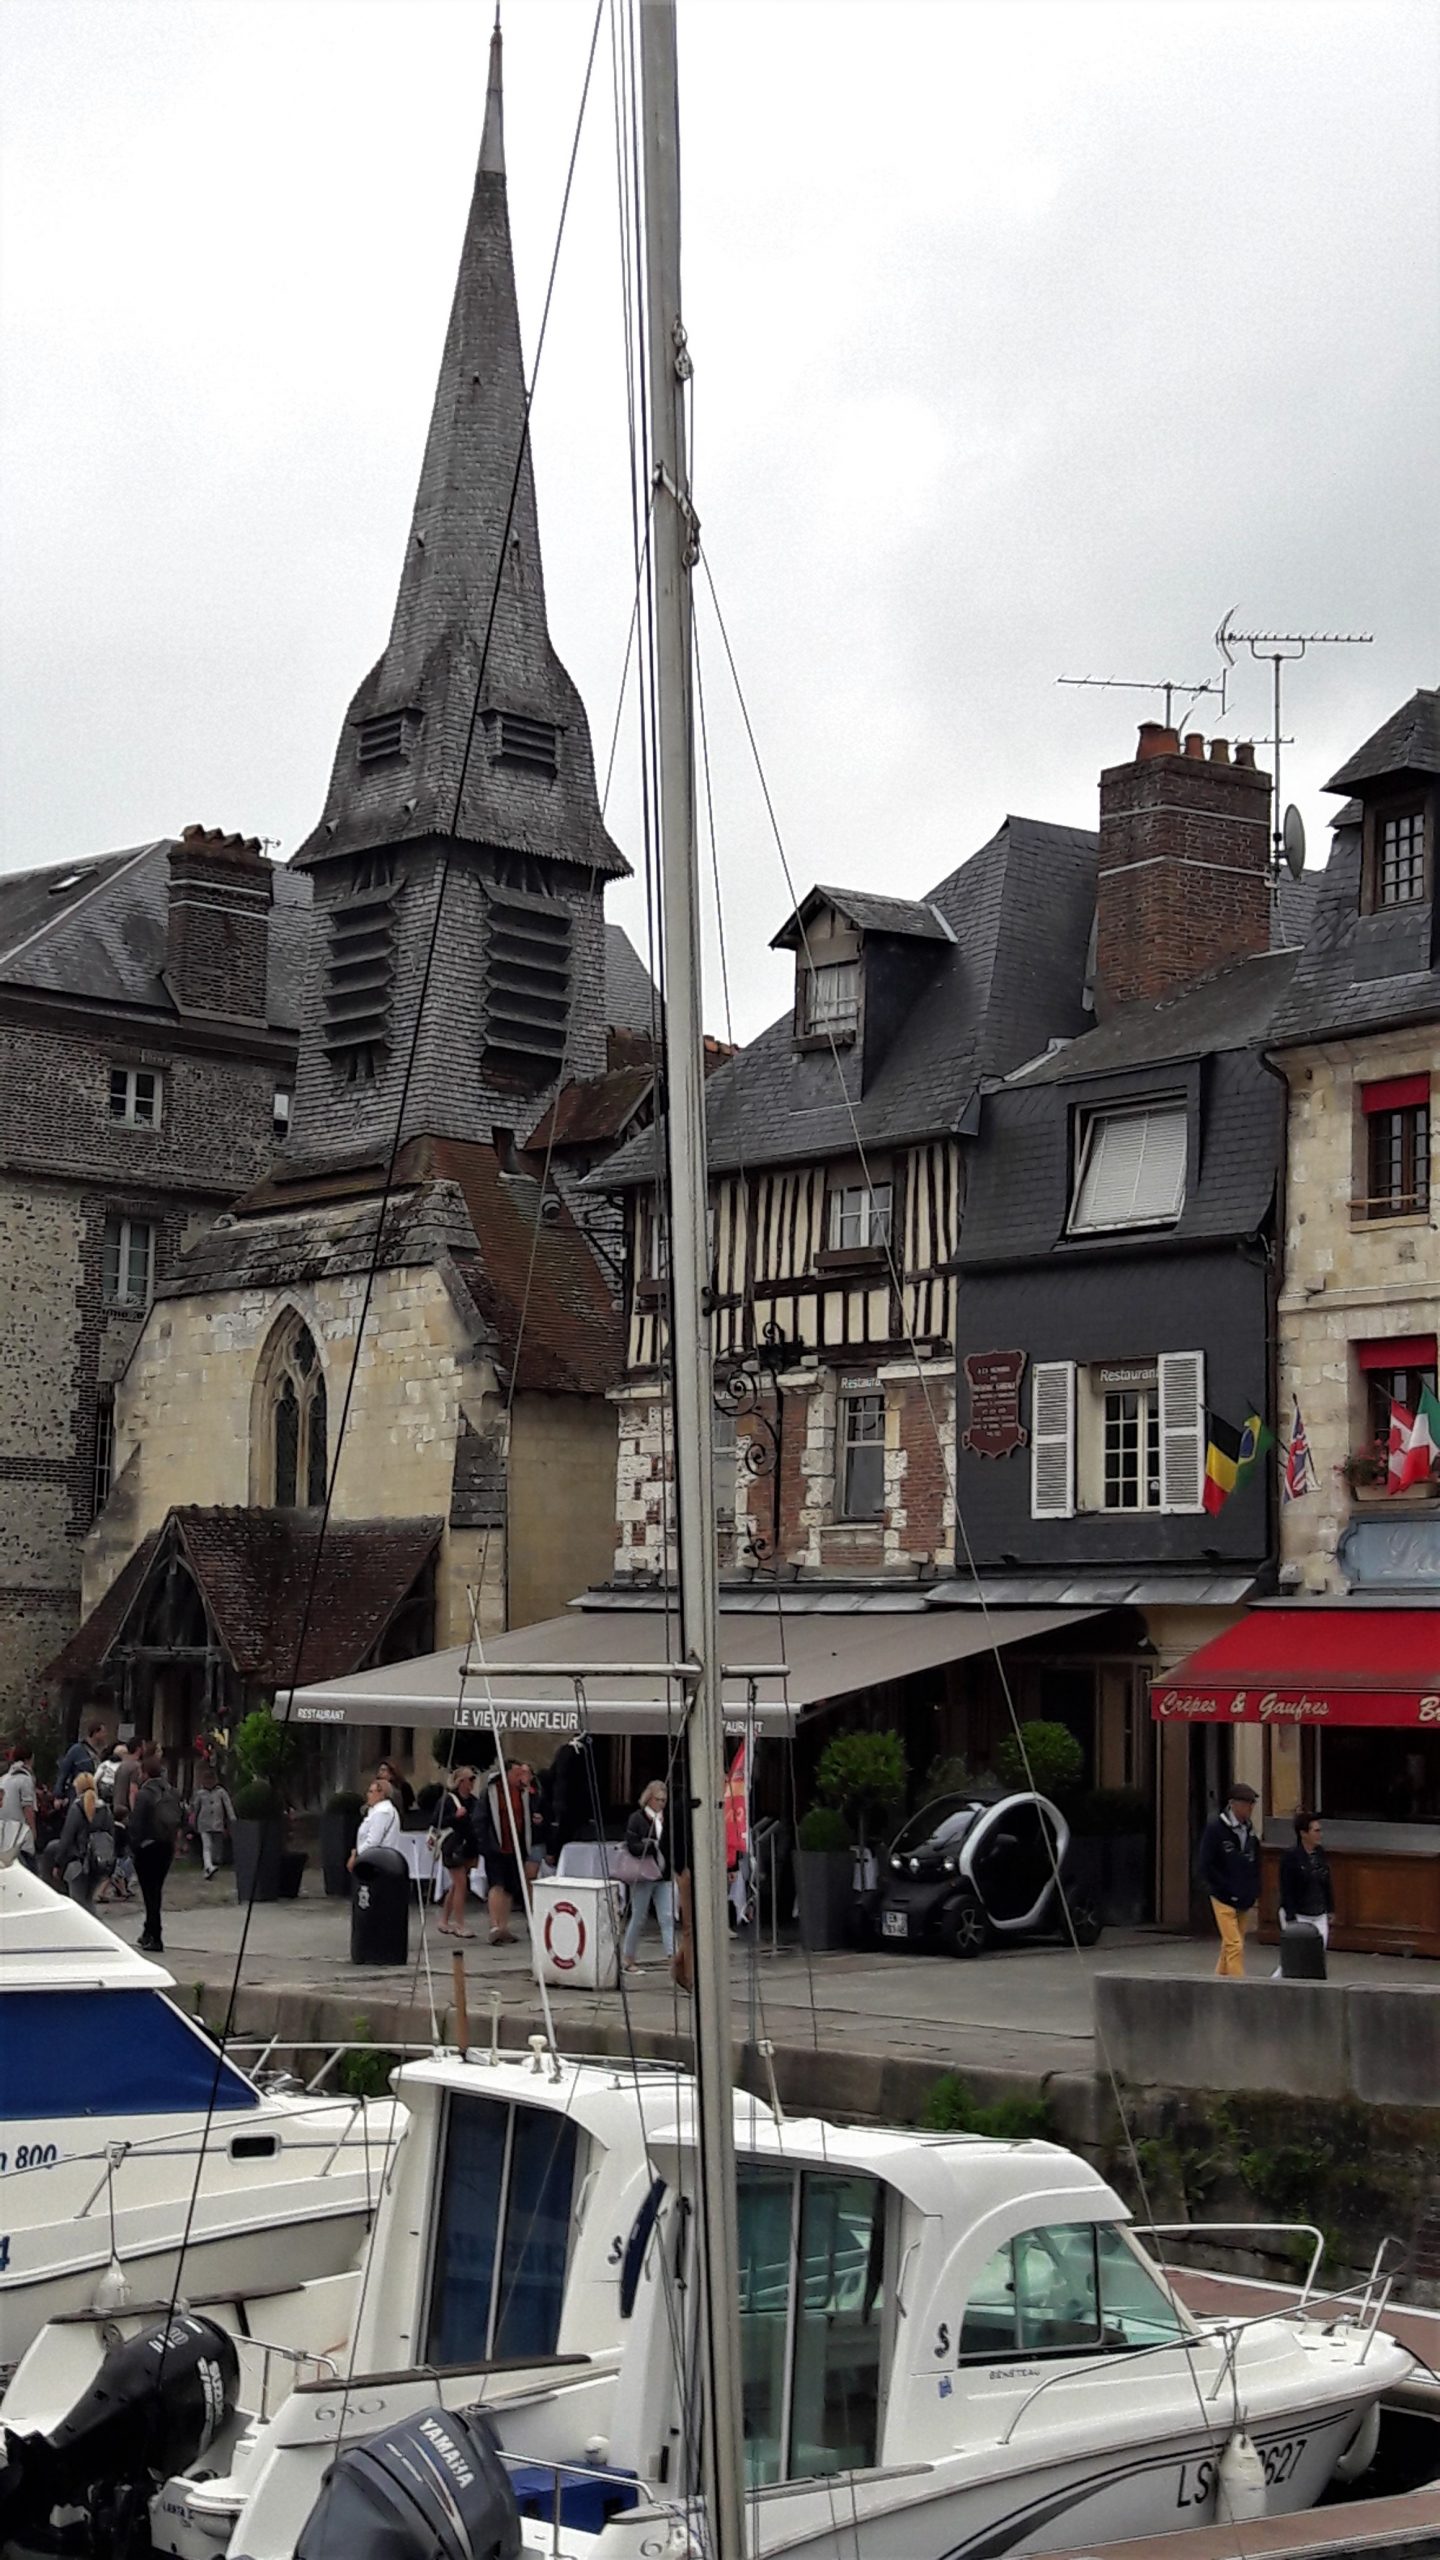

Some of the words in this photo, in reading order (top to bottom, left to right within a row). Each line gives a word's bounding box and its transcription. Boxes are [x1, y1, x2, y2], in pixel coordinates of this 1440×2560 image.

[841, 1377, 881, 1389] Restaura
[1101, 1369, 1157, 1382] Restauran
[297, 1707, 345, 1720] RESTAURANT
[1230, 1692, 1247, 1713] &
[1259, 1693, 1330, 1721] Gaufres
[453, 1709, 470, 1726] LE
[472, 1710, 508, 1728] VIEUX
[510, 1711, 579, 1730] HONFLEUR
[15, 2144, 57, 2170] 800
[418, 2417, 475, 2489] YAMAHA
[1177, 2461, 1213, 2508] LS
